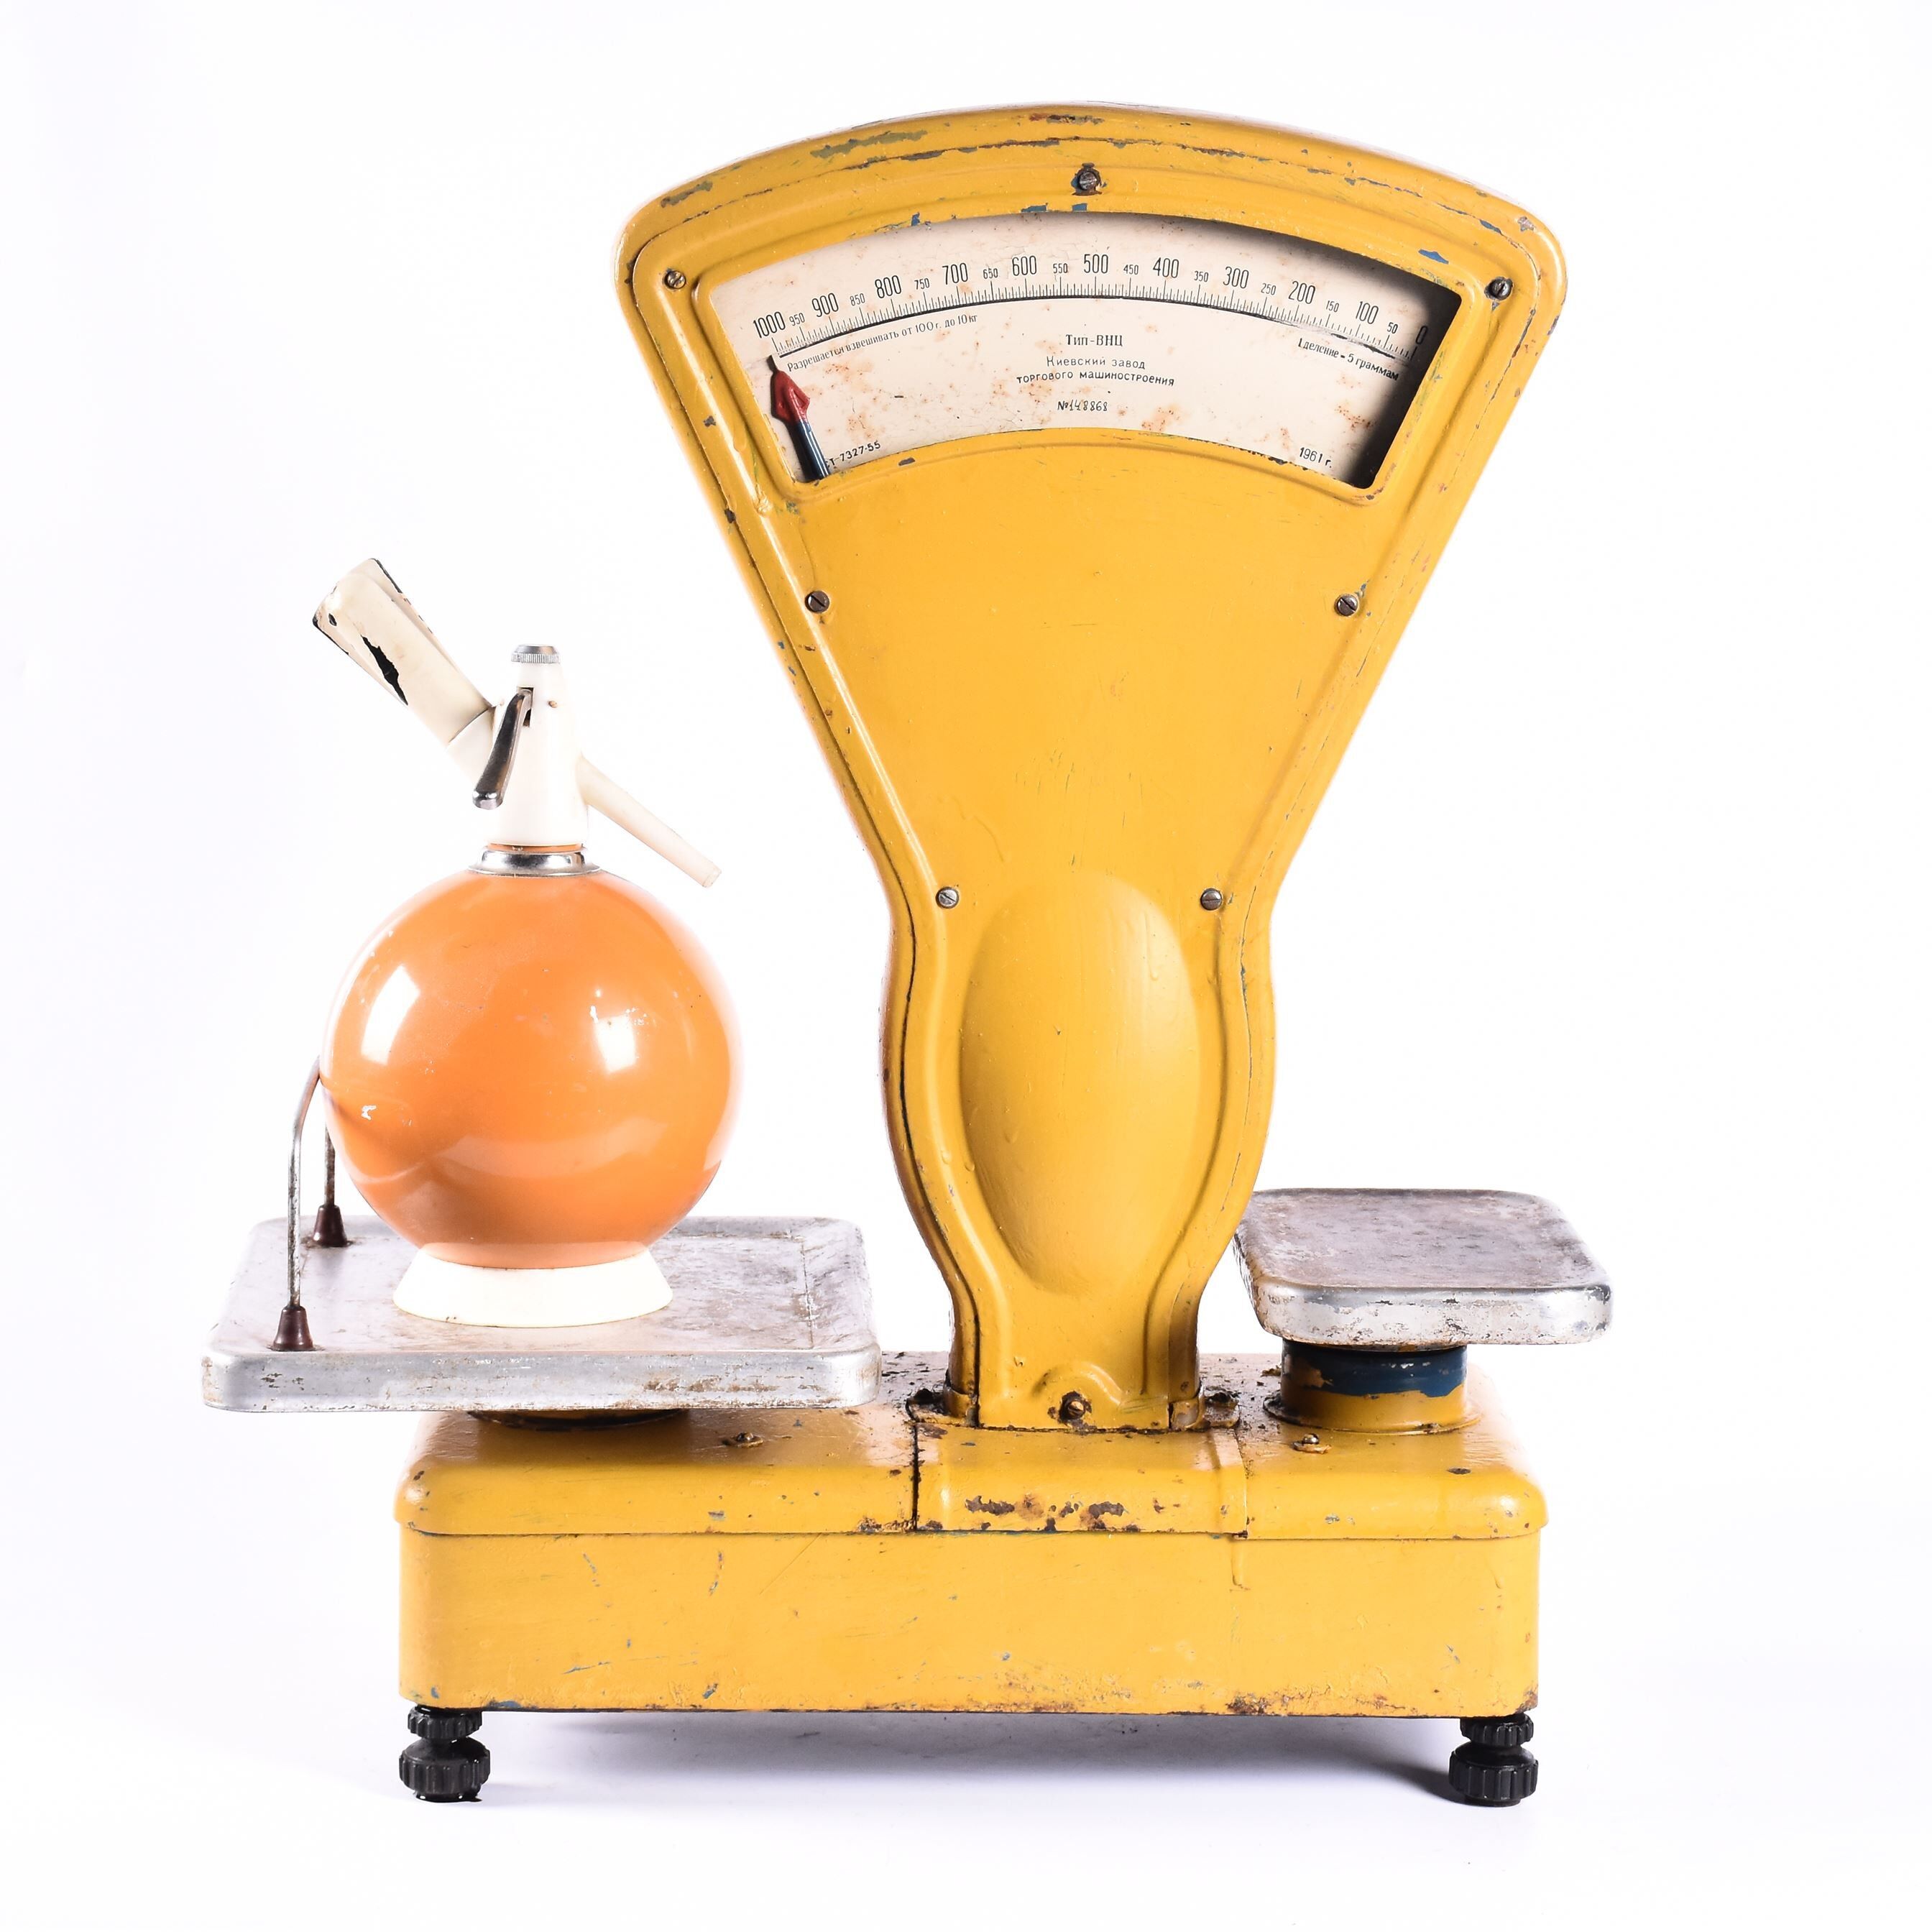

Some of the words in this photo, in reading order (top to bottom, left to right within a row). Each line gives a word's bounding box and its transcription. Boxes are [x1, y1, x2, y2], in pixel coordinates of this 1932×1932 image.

[753, 311, 786, 339] 1000
[788, 312, 806, 327] 950
[811, 293, 840, 318] 900
[850, 293, 865, 306] 850
[874, 275, 902, 300] 800
[914, 277, 930, 290] 750
[942, 262, 969, 285] 700
[983, 267, 998, 280] 650
[1011, 254, 1037, 277] 600
[1052, 262, 1069, 275] 550
[1083, 253, 1109, 275] 500
[1123, 264, 1139, 275] 450
[1152, 257, 1179, 279] 400
[1194, 270, 1209, 282] 350
[1223, 266, 1249, 289] 300
[1260, 282, 1276, 296] 250
[1288, 280, 1316, 305] 200
[1325, 300, 1340, 313] 150
[1355, 300, 1379, 325] 100
[1386, 321, 1399, 334] 50
[1415, 325, 1428, 345] 0
[787, 346, 844, 372] Разрешается
[845, 331, 899, 353] взвешивать
[901, 327, 913, 336] от
[944, 318, 955, 328] до
[1046, 355, 1105, 367] Киевский
[1112, 359, 1146, 370] завод
[1347, 353, 1354, 363] 5
[1356, 359, 1399, 381] граммам
[1016, 370, 1074, 385] торгового
[1079, 371, 1175, 387] машиностроения
[1300, 446, 1323, 464] 1961
